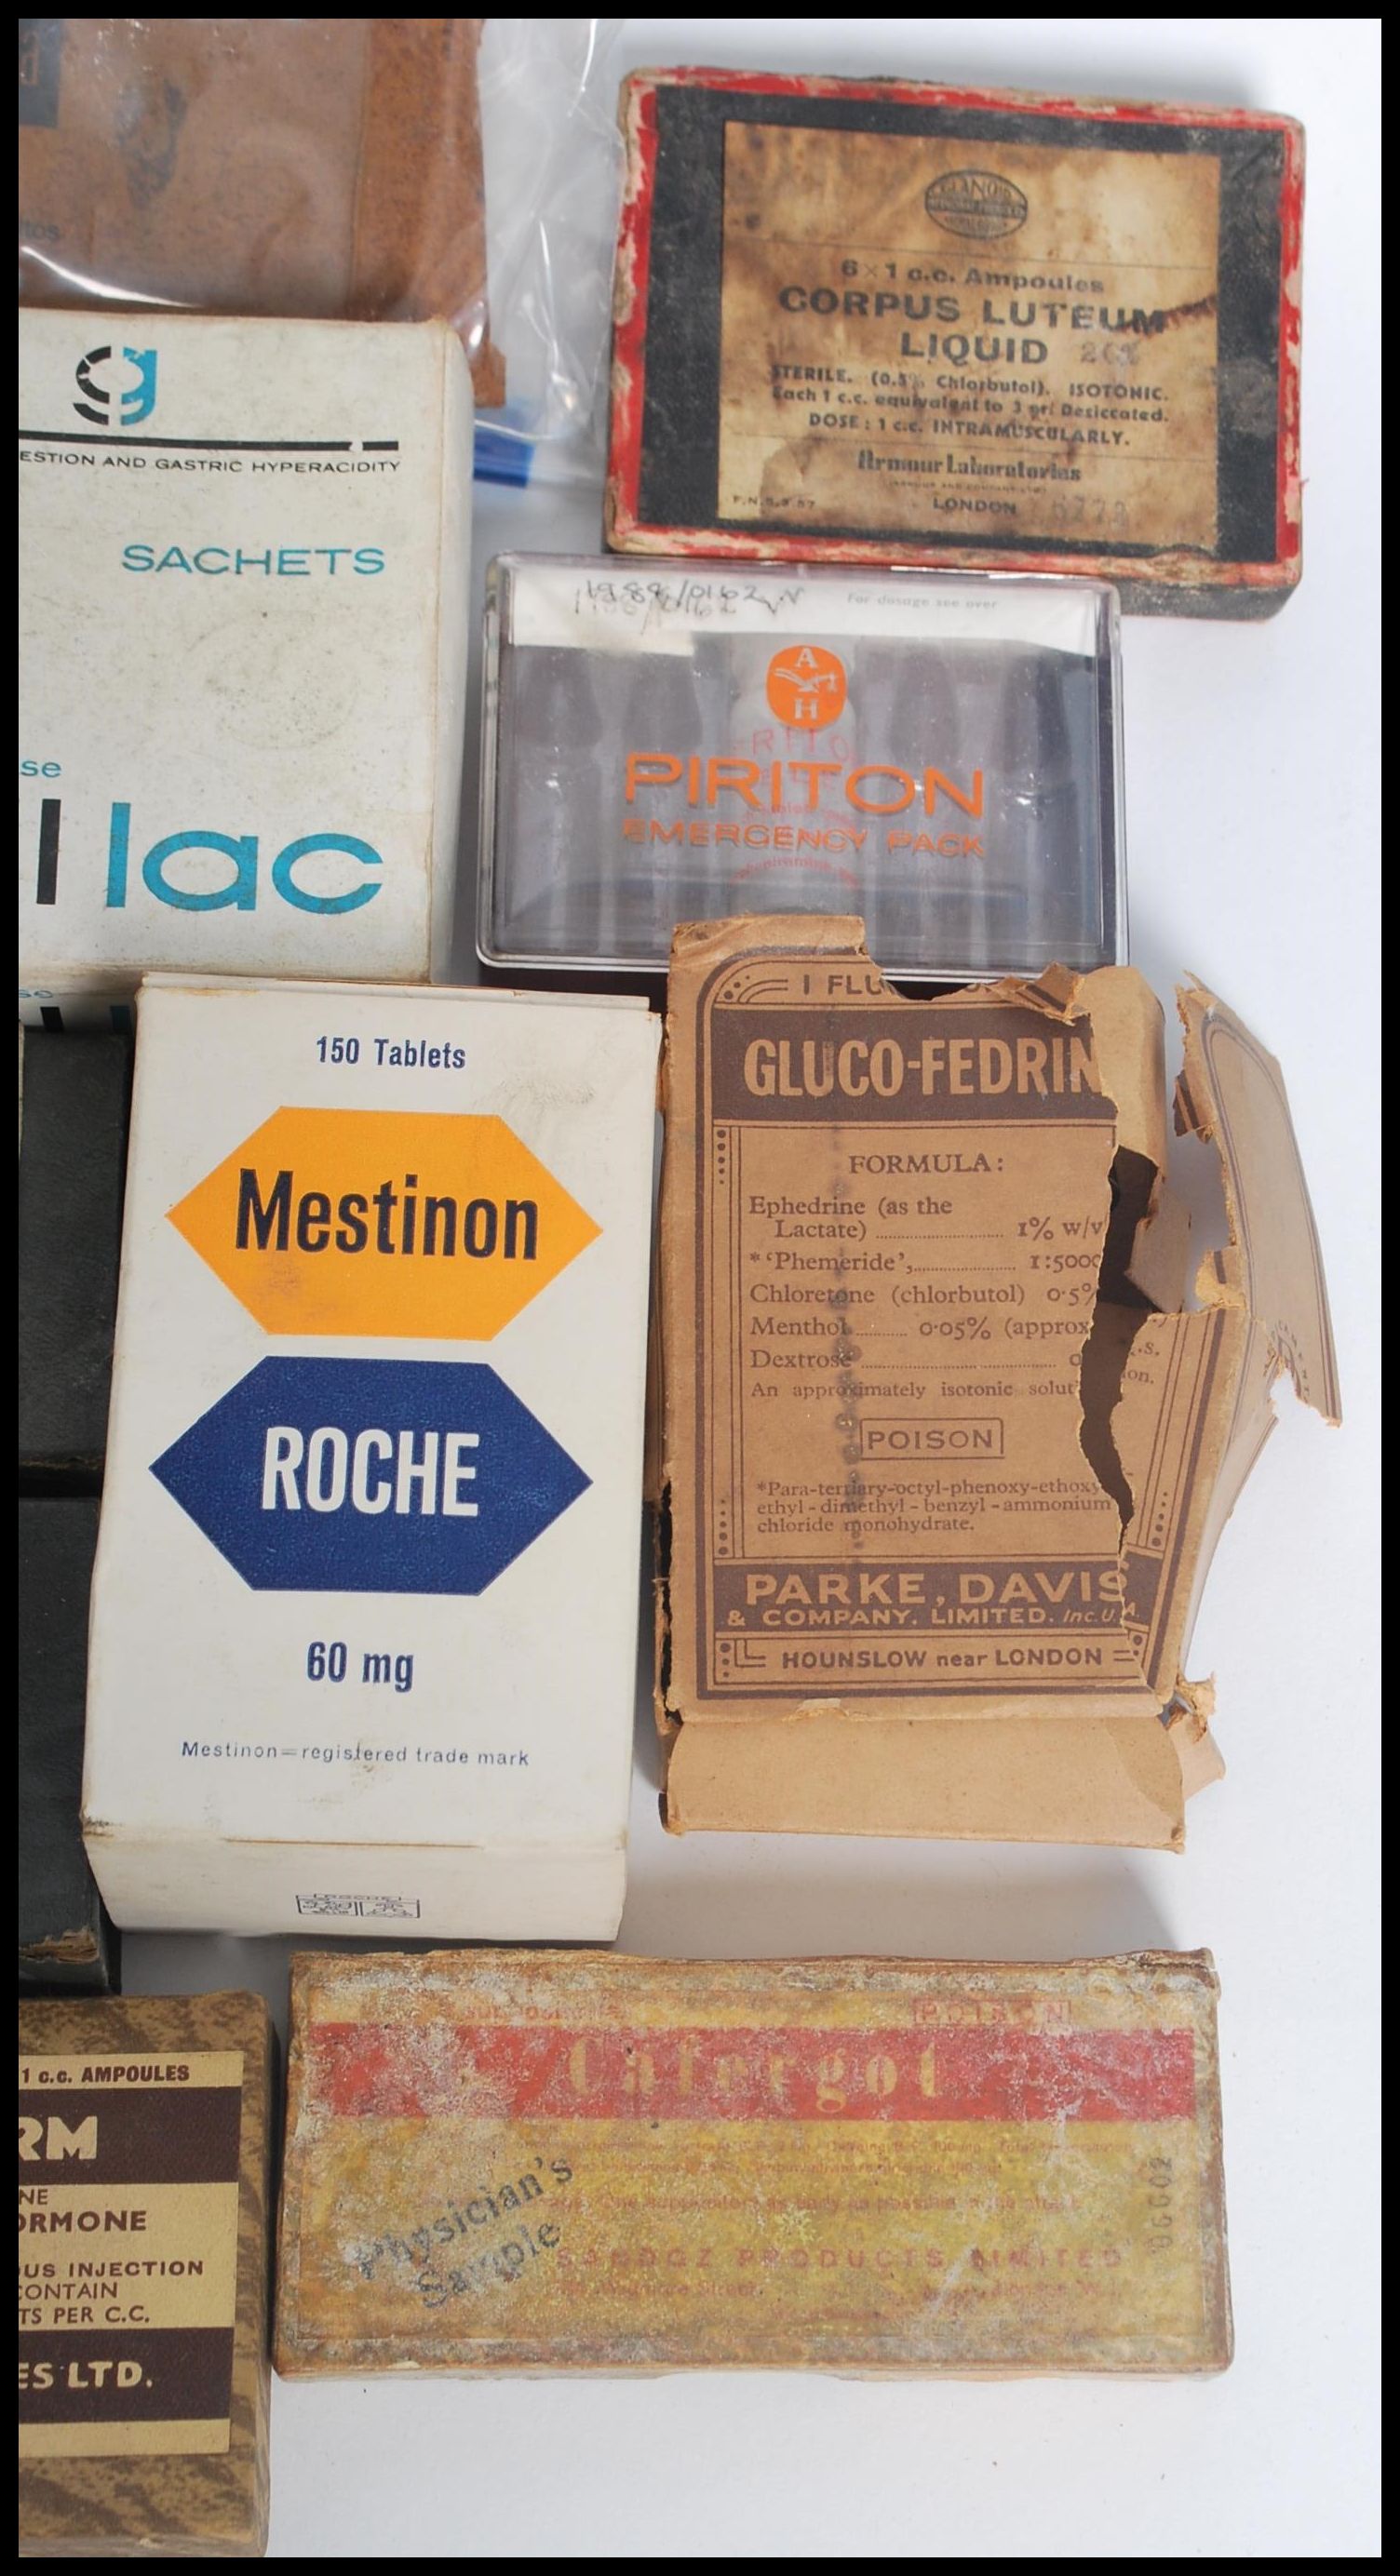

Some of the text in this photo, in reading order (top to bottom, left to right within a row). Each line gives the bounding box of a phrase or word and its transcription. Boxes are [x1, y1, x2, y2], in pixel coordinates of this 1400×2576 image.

[841, 259, 858, 277] 6
[885, 262, 897, 278] 1
[965, 268, 1104, 293] Ampoules
[778, 285, 1164, 335] CORPUS LUTEUM
[901, 331, 1048, 367] LIQUID
[772, 365, 853, 382] STERILE.
[1070, 382, 1169, 401] ISOTONIC.
[773, 386, 815, 402] Each
[824, 390, 830, 402] 1
[875, 395, 978, 412] equivalent
[984, 399, 1003, 412] to
[1061, 403, 1169, 422] Desiccated.
[880, 418, 885, 431] 1
[934, 420, 1129, 445] INTRAMUSCULARLY.
[20, 450, 400, 473] ESTION AND GASTRIC HYPERACIDITY
[858, 449, 1081, 481] Armour Laboratories
[934, 497, 1016, 515] LONDON
[122, 545, 384, 575] SACHETS
[877, 594, 930, 608] dosage
[936, 598, 960, 608] see
[966, 600, 997, 610] over
[795, 648, 818, 668] A
[794, 698, 817, 719] H
[626, 752, 983, 819] PIRITON
[623, 819, 985, 858] EMERGENCY PACK
[107, 802, 384, 915] lac
[316, 1036, 465, 1069] 150 Tablets
[745, 1038, 1102, 1097] GLUCO-FEDRIN
[849, 1153, 1003, 1174] FORMULA:
[235, 1168, 539, 1261] Mestinon
[749, 1196, 952, 1219] Ephedrine (as the
[774, 1219, 867, 1241] Lactate)
[1062, 1216, 1103, 1239] w/v
[749, 1283, 875, 1303] Chloretone
[892, 1284, 1024, 1308] (chlorbutol)
[750, 1316, 851, 1335] Menthol
[750, 1348, 852, 1368] Dextrose
[751, 1382, 778, 1397] An
[793, 1381, 925, 1400] approximately
[942, 1380, 1013, 1396] isotonic
[868, 1429, 992, 1450] POISON
[262, 1427, 479, 1517] ROCHE
[758, 1500, 803, 1517] ethyl
[820, 1498, 905, 1516] dimethyl
[924, 1496, 985, 1515] benzyl
[1003, 1496, 1111, 1512] ammonium
[758, 1516, 975, 1534] chloride monohydrate.
[960, 1565, 1128, 1603] DAVIS
[728, 1611, 745, 1627] &
[306, 1642, 414, 1693] 60 mg
[783, 1647, 1102, 1670] HOUNSLOW near LONDON
[417, 1747, 468, 1765] trade
[478, 1750, 530, 1767] mark
[22, 2065, 190, 2084] 1 c.c. AMPOULES
[19, 2260, 204, 2279] US INJECTION
[737, 2247, 945, 2269] PRODUCTS
[19, 2283, 117, 2301] ONTAIN
[54, 2305, 94, 2324] PER
[105, 2304, 150, 2324] C.C.
[68, 2360, 153, 2389] LTD.
